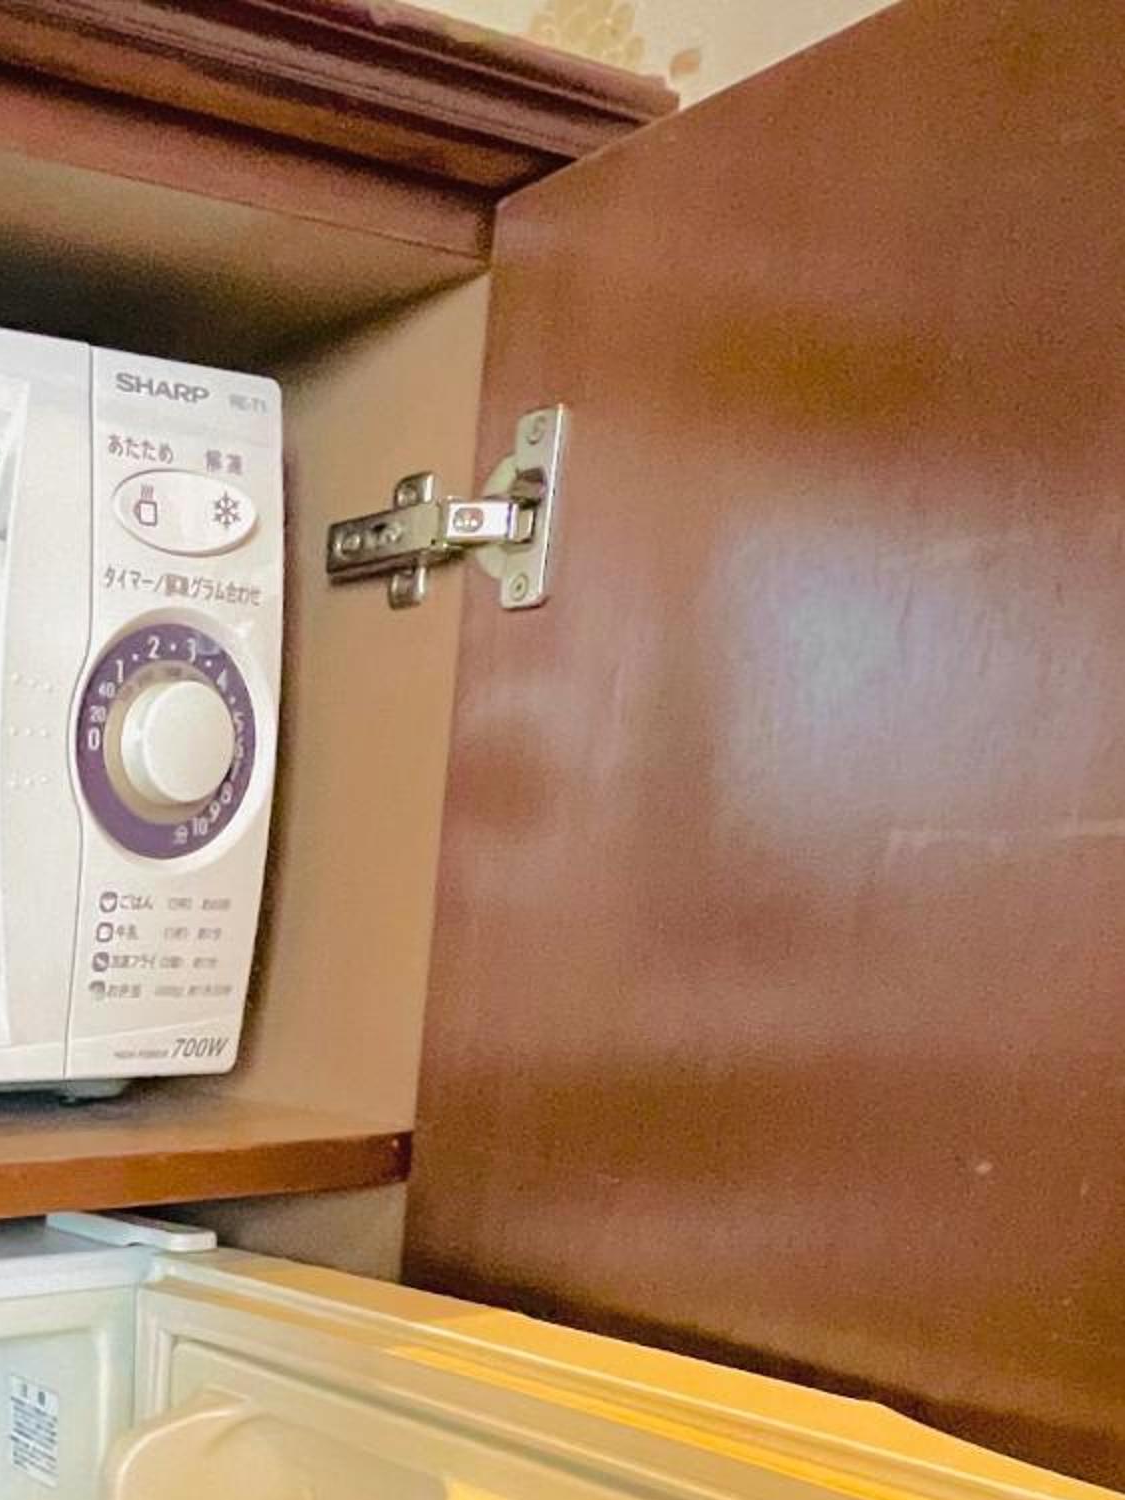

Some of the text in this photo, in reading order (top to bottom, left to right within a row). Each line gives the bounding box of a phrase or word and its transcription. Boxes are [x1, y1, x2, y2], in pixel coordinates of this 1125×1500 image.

[116, 372, 210, 404] SHARP
[107, 434, 174, 464] あたため
[147, 636, 161, 659] 2
[186, 638, 197, 661] 3
[115, 659, 124, 683] 1
[89, 705, 107, 723] 20
[87, 728, 101, 751] 0
[209, 801, 221, 822] 9
[191, 817, 208, 837] 10
[171, 1037, 230, 1058] 700W
